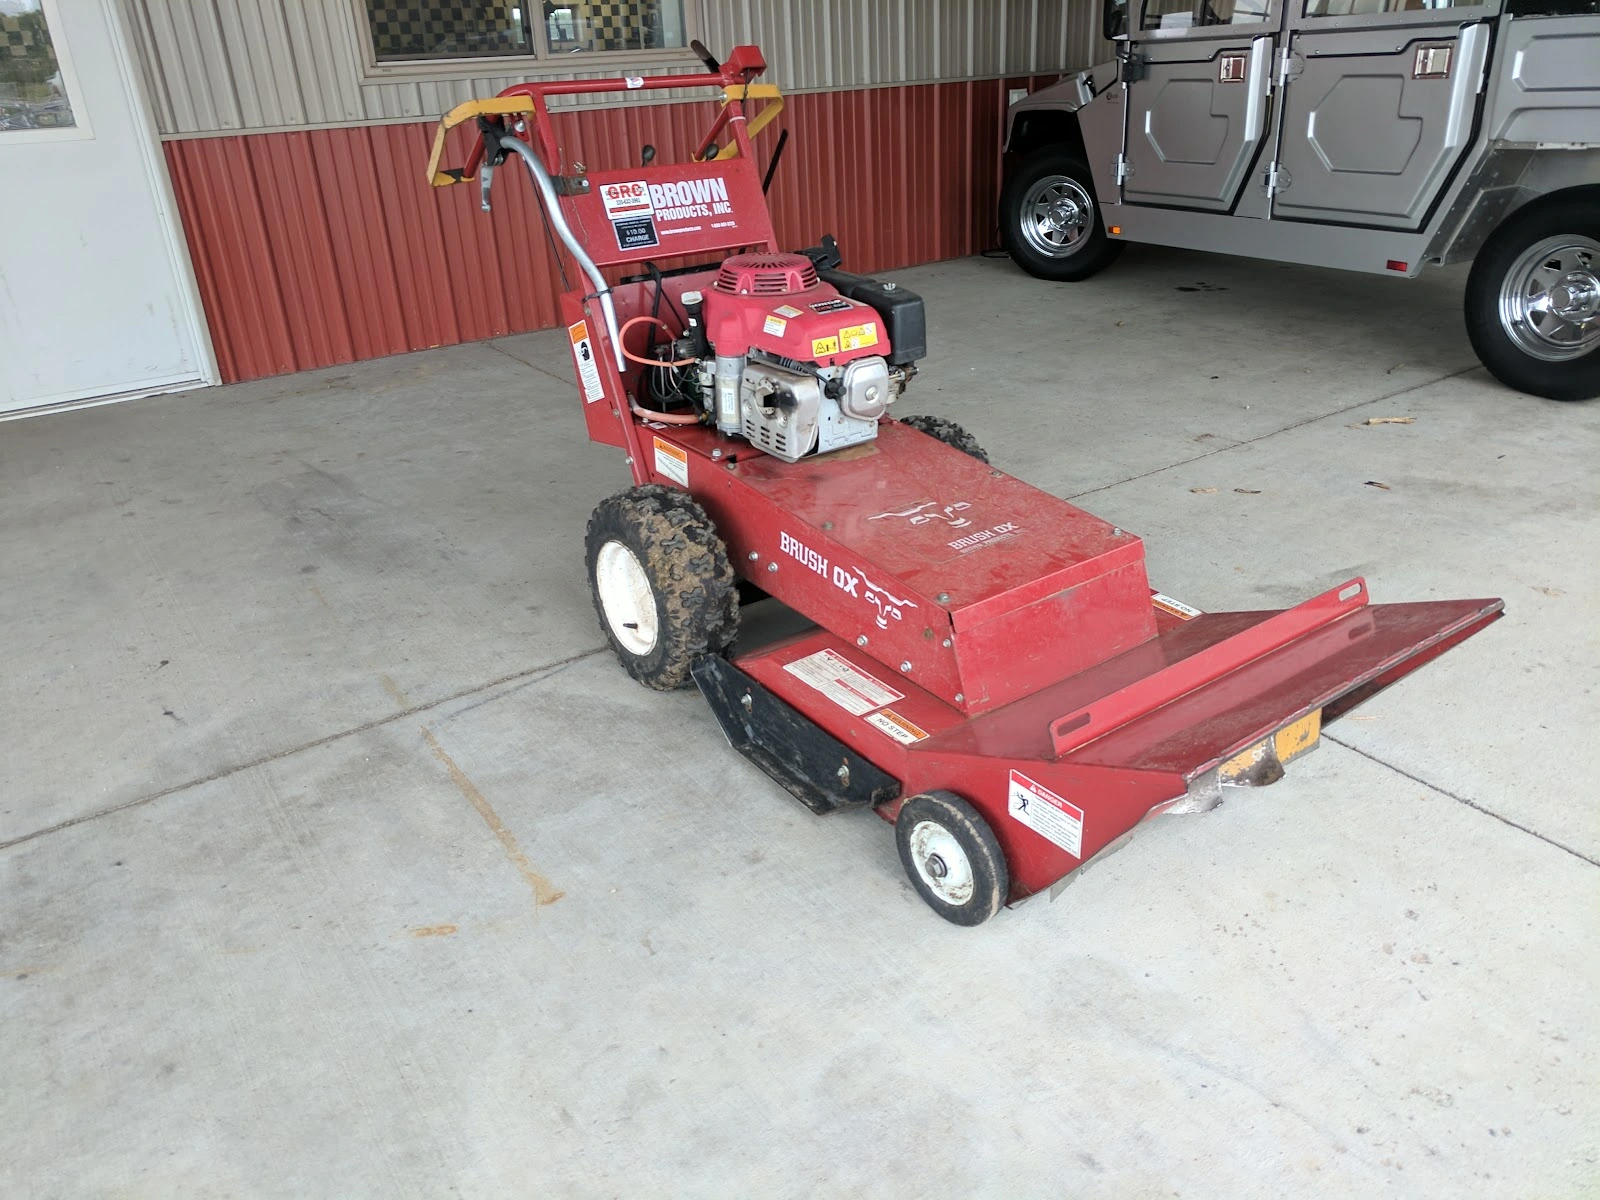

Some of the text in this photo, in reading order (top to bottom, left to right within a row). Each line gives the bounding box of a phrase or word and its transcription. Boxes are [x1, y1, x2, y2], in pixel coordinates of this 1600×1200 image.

[608, 183, 642, 199] GRC
[648, 177, 728, 208] BROWN
[655, 204, 712, 221] PRODUCTS,
[713, 202, 733, 214] INC.
[626, 234, 650, 243] CHARGE
[947, 529, 995, 550] BRUSH
[996, 521, 1019, 534] OX
[780, 531, 858, 598] BRUSH OX
[877, 717, 908, 739] NO STEP
[1037, 788, 1063, 809] DANGER
